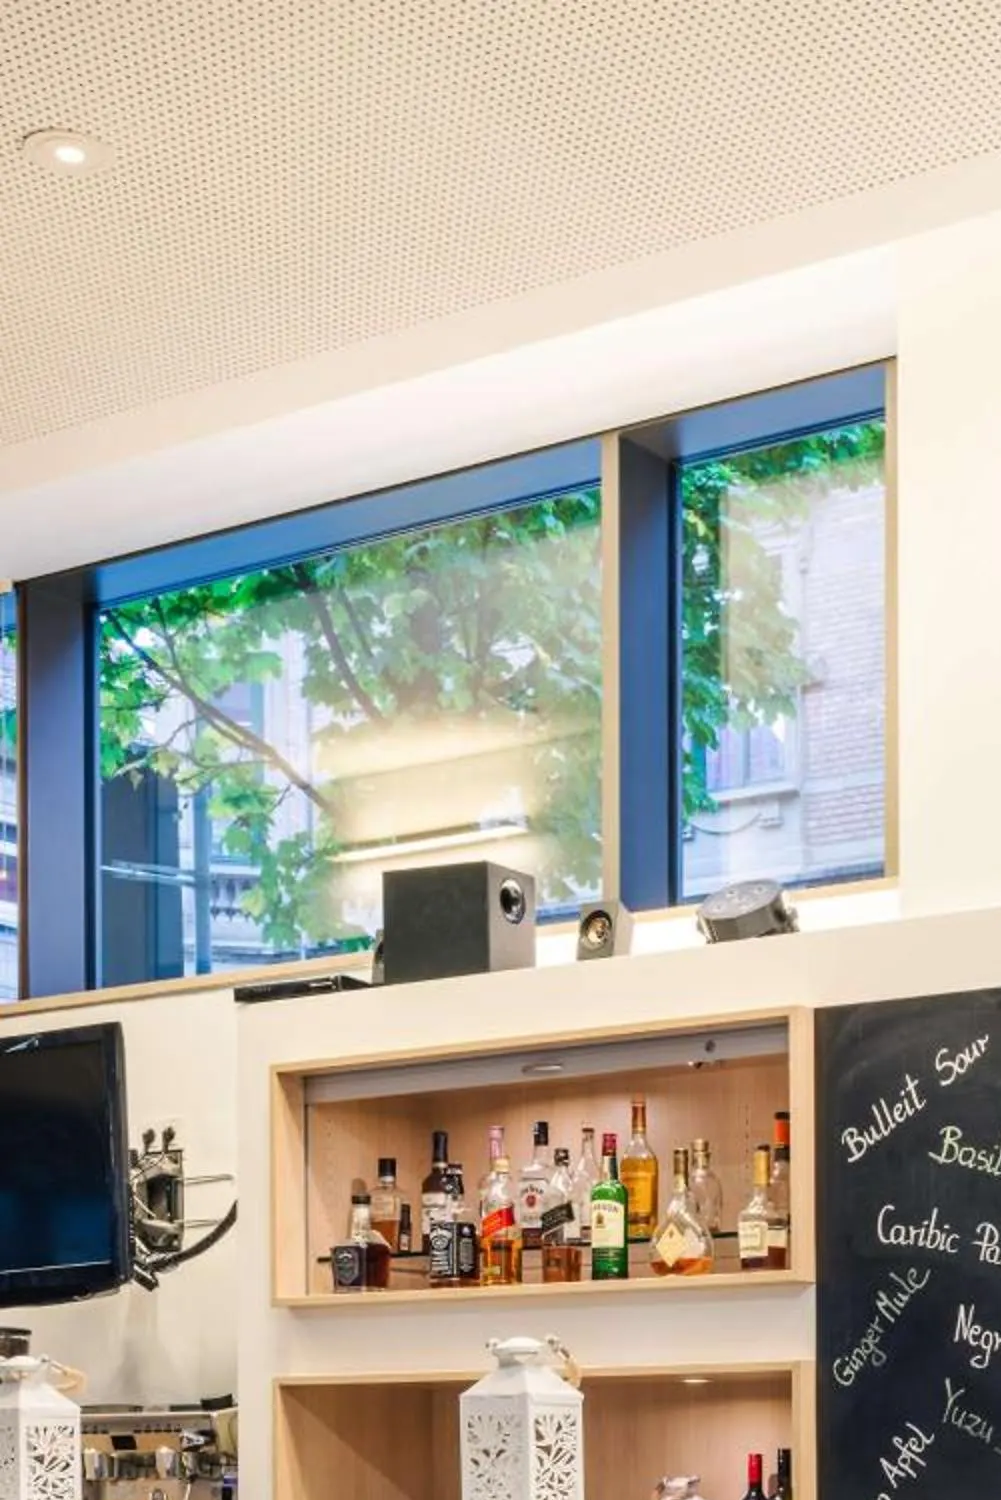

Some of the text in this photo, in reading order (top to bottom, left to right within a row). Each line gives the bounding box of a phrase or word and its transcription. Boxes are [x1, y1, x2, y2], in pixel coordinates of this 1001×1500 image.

[842, 1033, 989, 1162] Bulleit Sour
[876, 1204, 960, 1253] Caribic
[833, 1267, 932, 1387] Ginger Mule
[943, 1377, 994, 1443] Yuzu
[879, 1421, 935, 1488] Apfel
